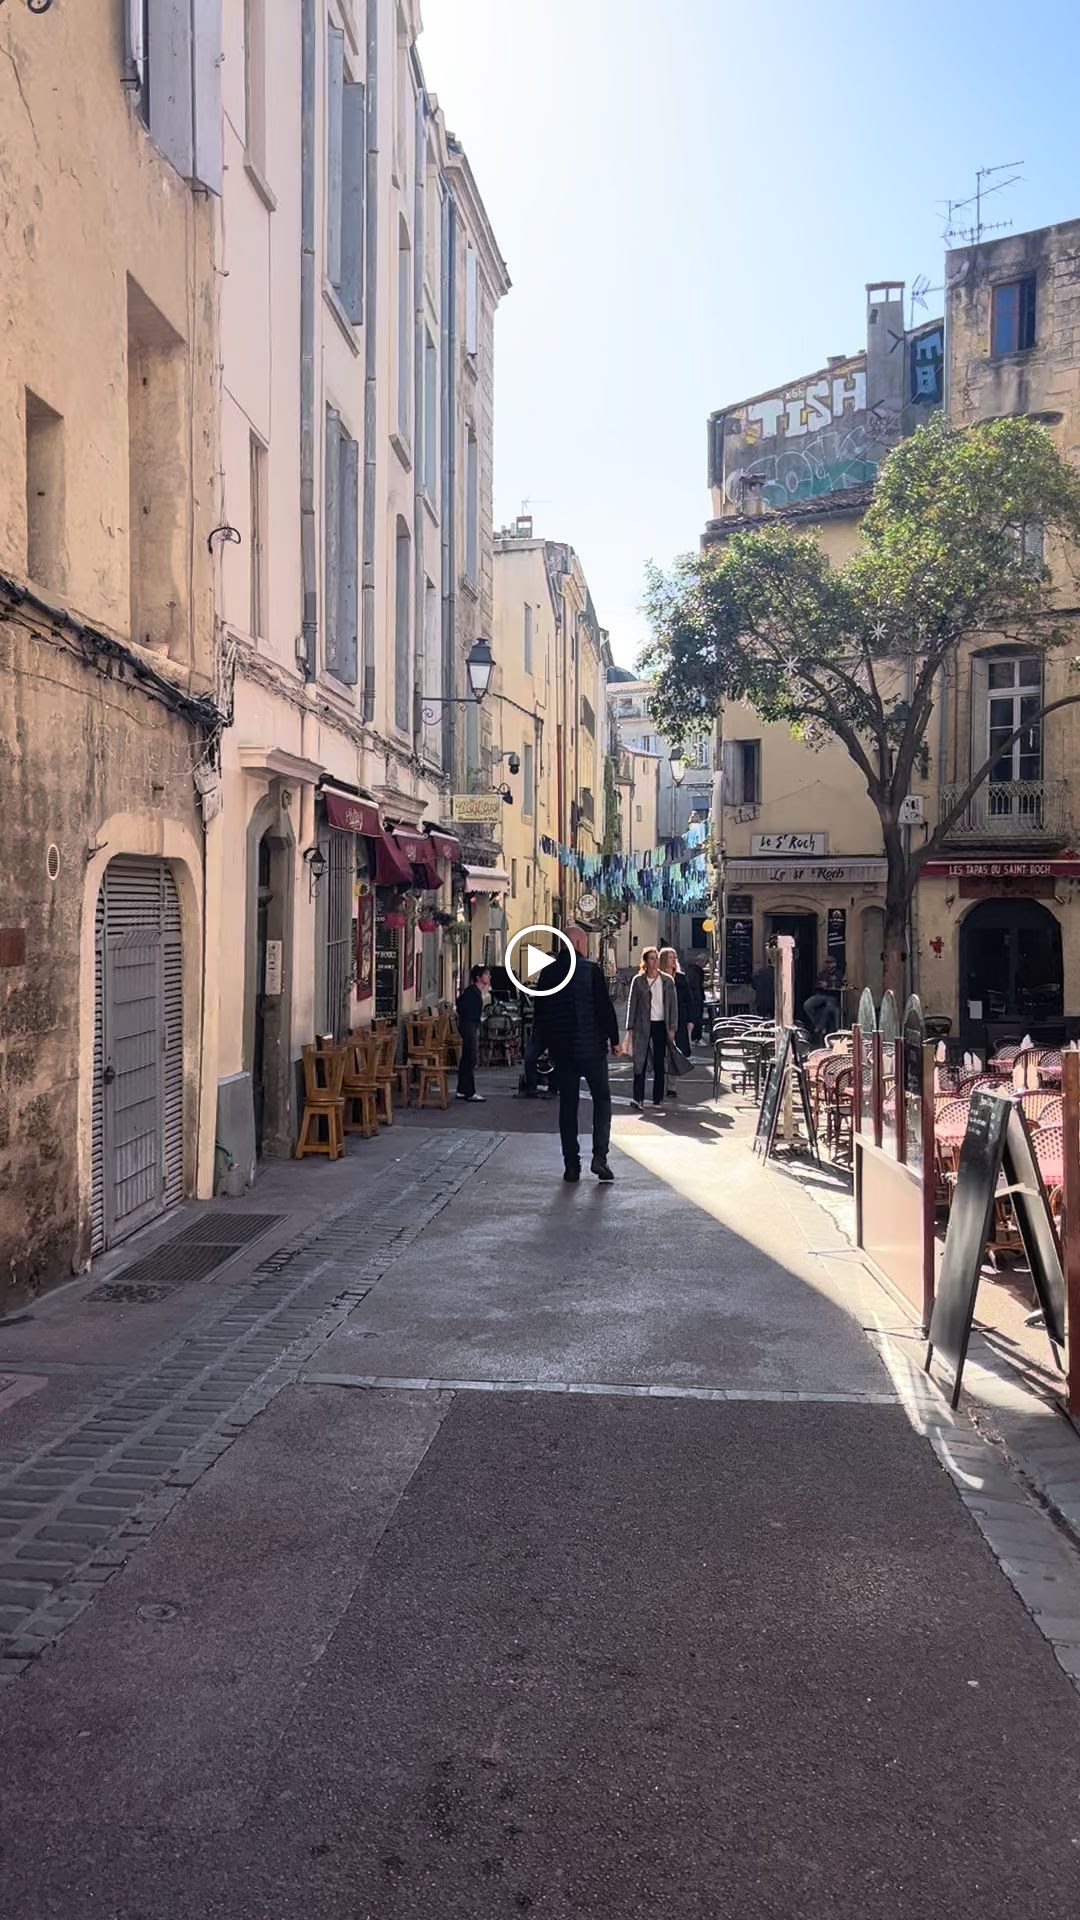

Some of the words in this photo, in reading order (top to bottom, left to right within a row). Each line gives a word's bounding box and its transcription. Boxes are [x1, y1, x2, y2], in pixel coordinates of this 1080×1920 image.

[748, 372, 867, 438] TISH
[760, 836, 772, 847] Le
[789, 834, 815, 851] Roch
[949, 865, 963, 875] LES
[966, 865, 988, 875] TAPAS
